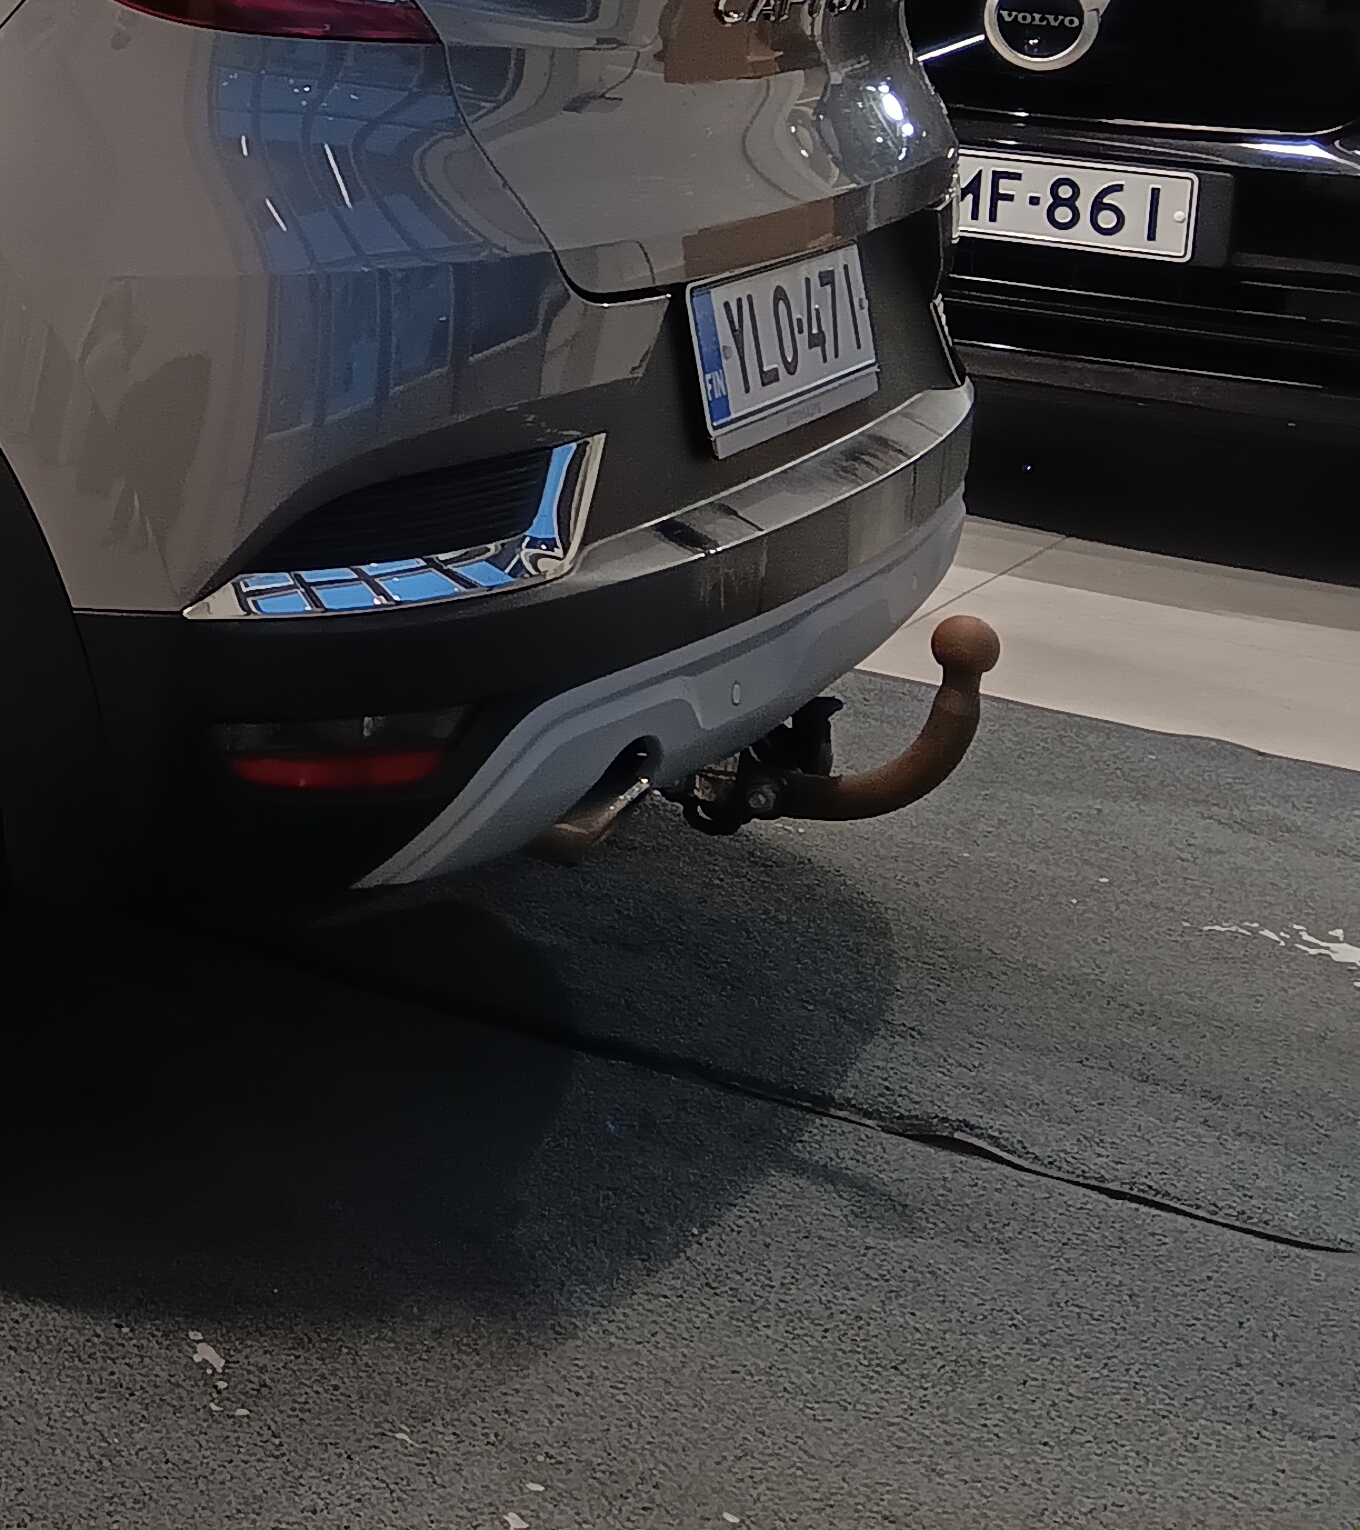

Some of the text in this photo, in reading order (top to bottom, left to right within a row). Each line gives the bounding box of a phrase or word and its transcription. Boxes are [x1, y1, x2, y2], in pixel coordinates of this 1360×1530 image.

[1000, 10, 1080, 29] VOLVO
[723, 264, 862, 394] YLO-471
[705, 369, 728, 401] FIN
